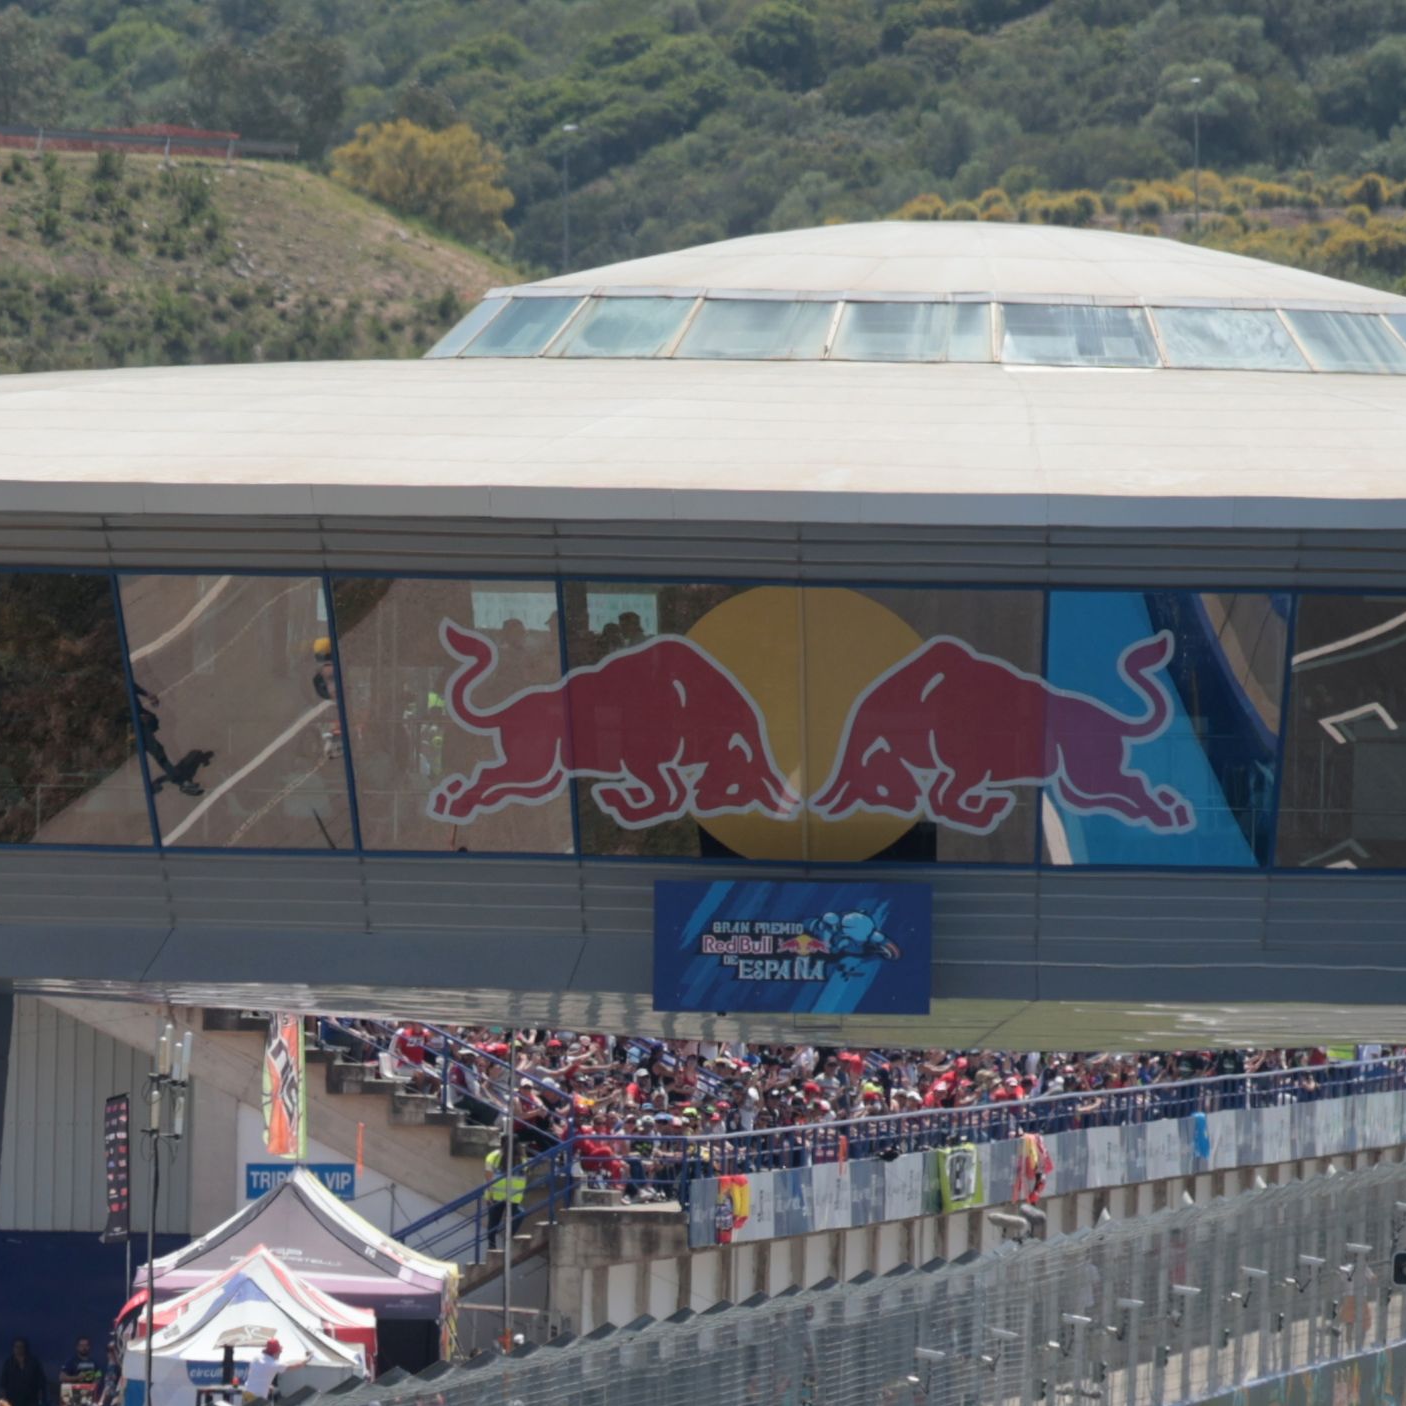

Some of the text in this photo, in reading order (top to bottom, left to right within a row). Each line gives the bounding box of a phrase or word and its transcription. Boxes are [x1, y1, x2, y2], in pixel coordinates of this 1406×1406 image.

[712, 921, 804, 935] GRAN PREMIO
[738, 956, 825, 980] ESPAÑA
[325, 1172, 352, 1190] VIP
